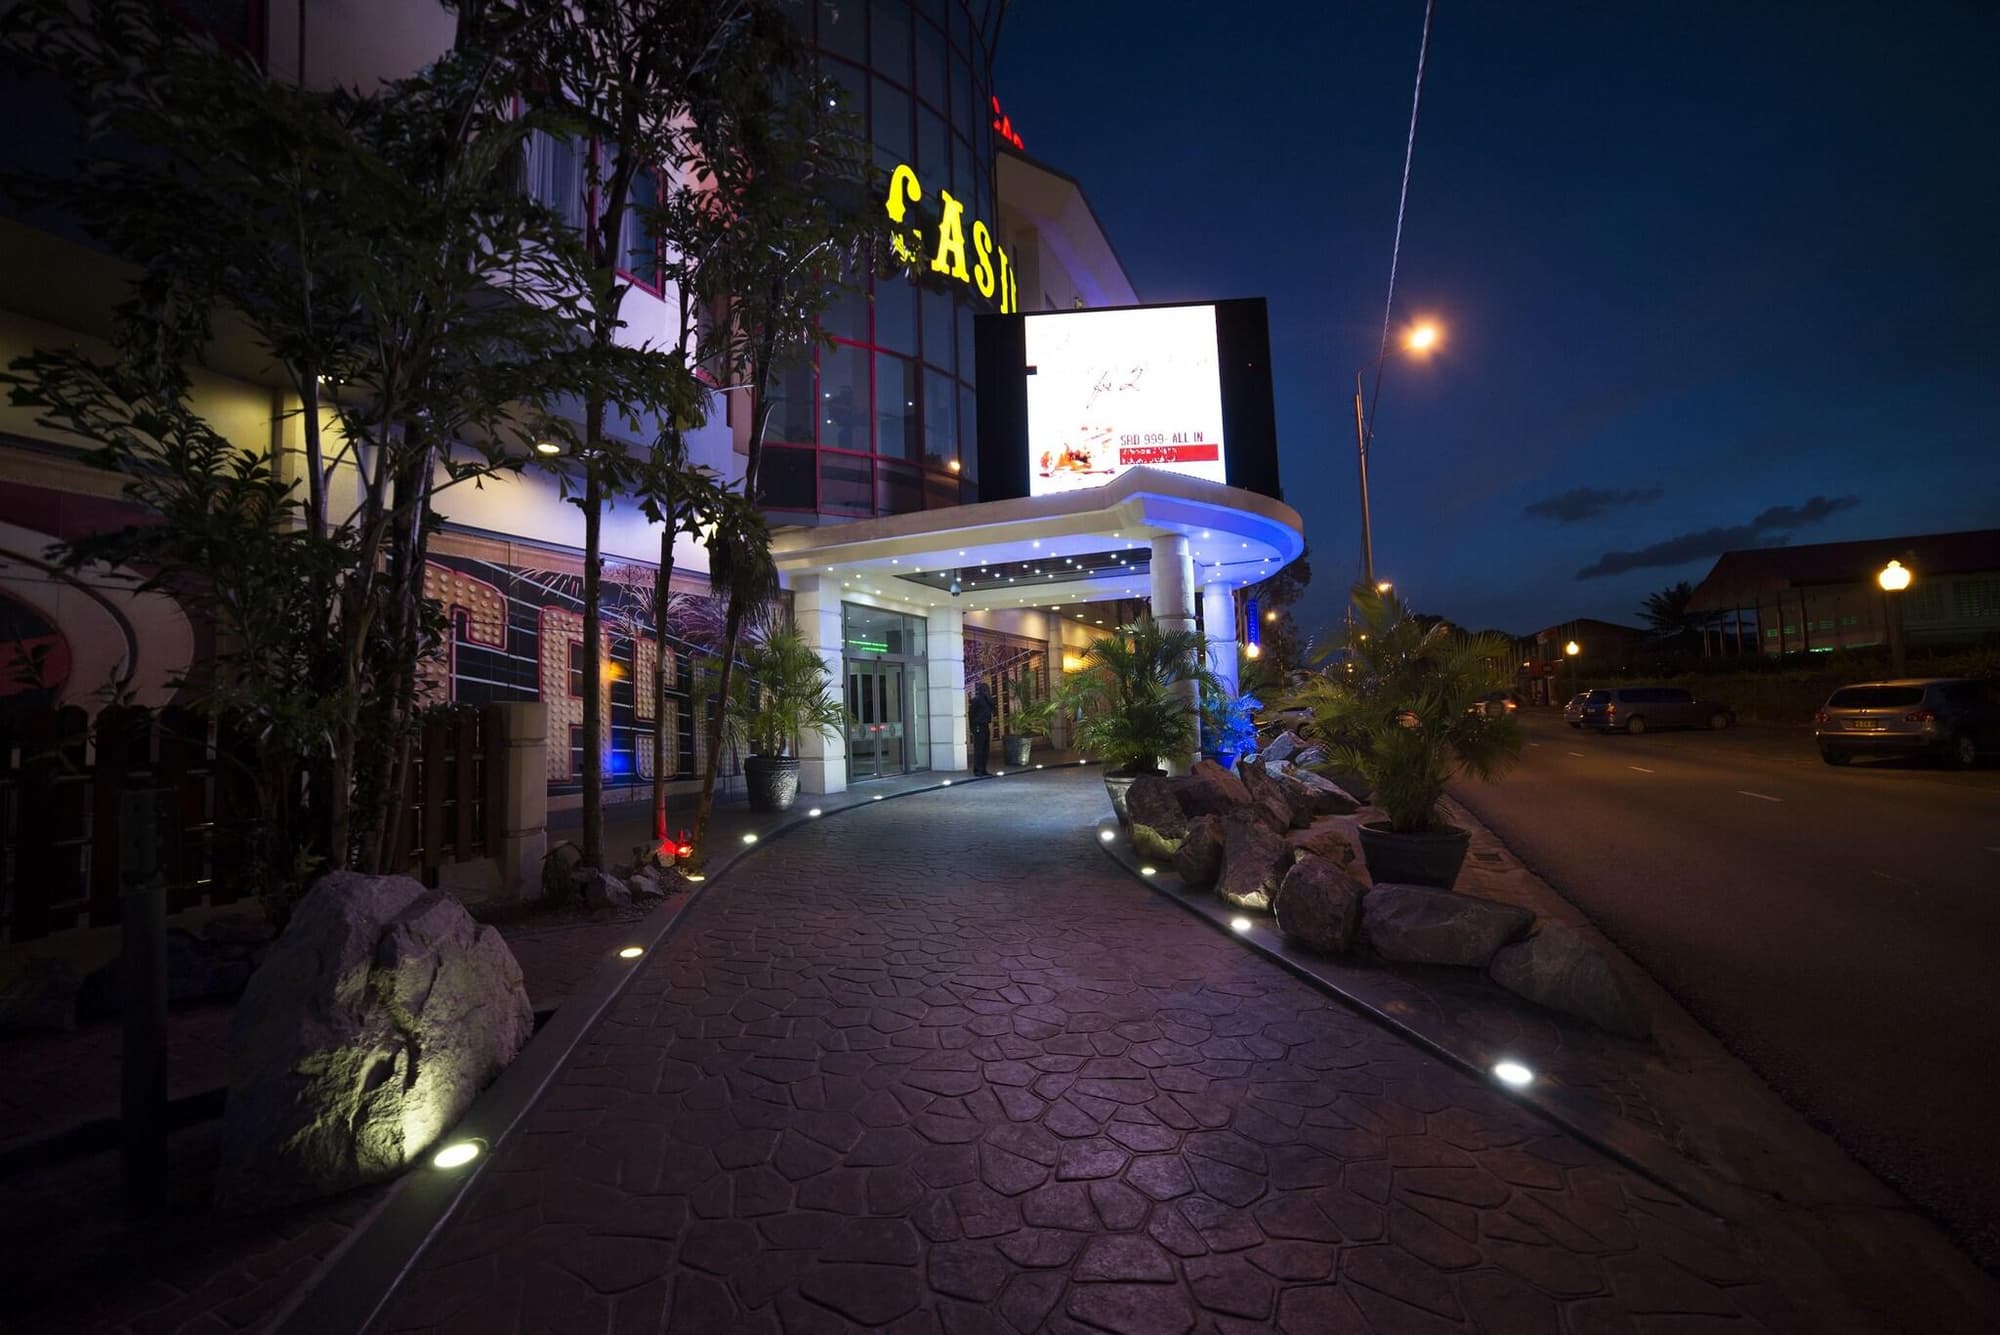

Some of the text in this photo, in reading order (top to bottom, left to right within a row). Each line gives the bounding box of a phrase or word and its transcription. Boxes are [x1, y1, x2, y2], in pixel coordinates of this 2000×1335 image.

[886, 164, 1017, 314] CASI
[1172, 432, 1189, 444] ALL
[1193, 431, 1204, 443] IN
